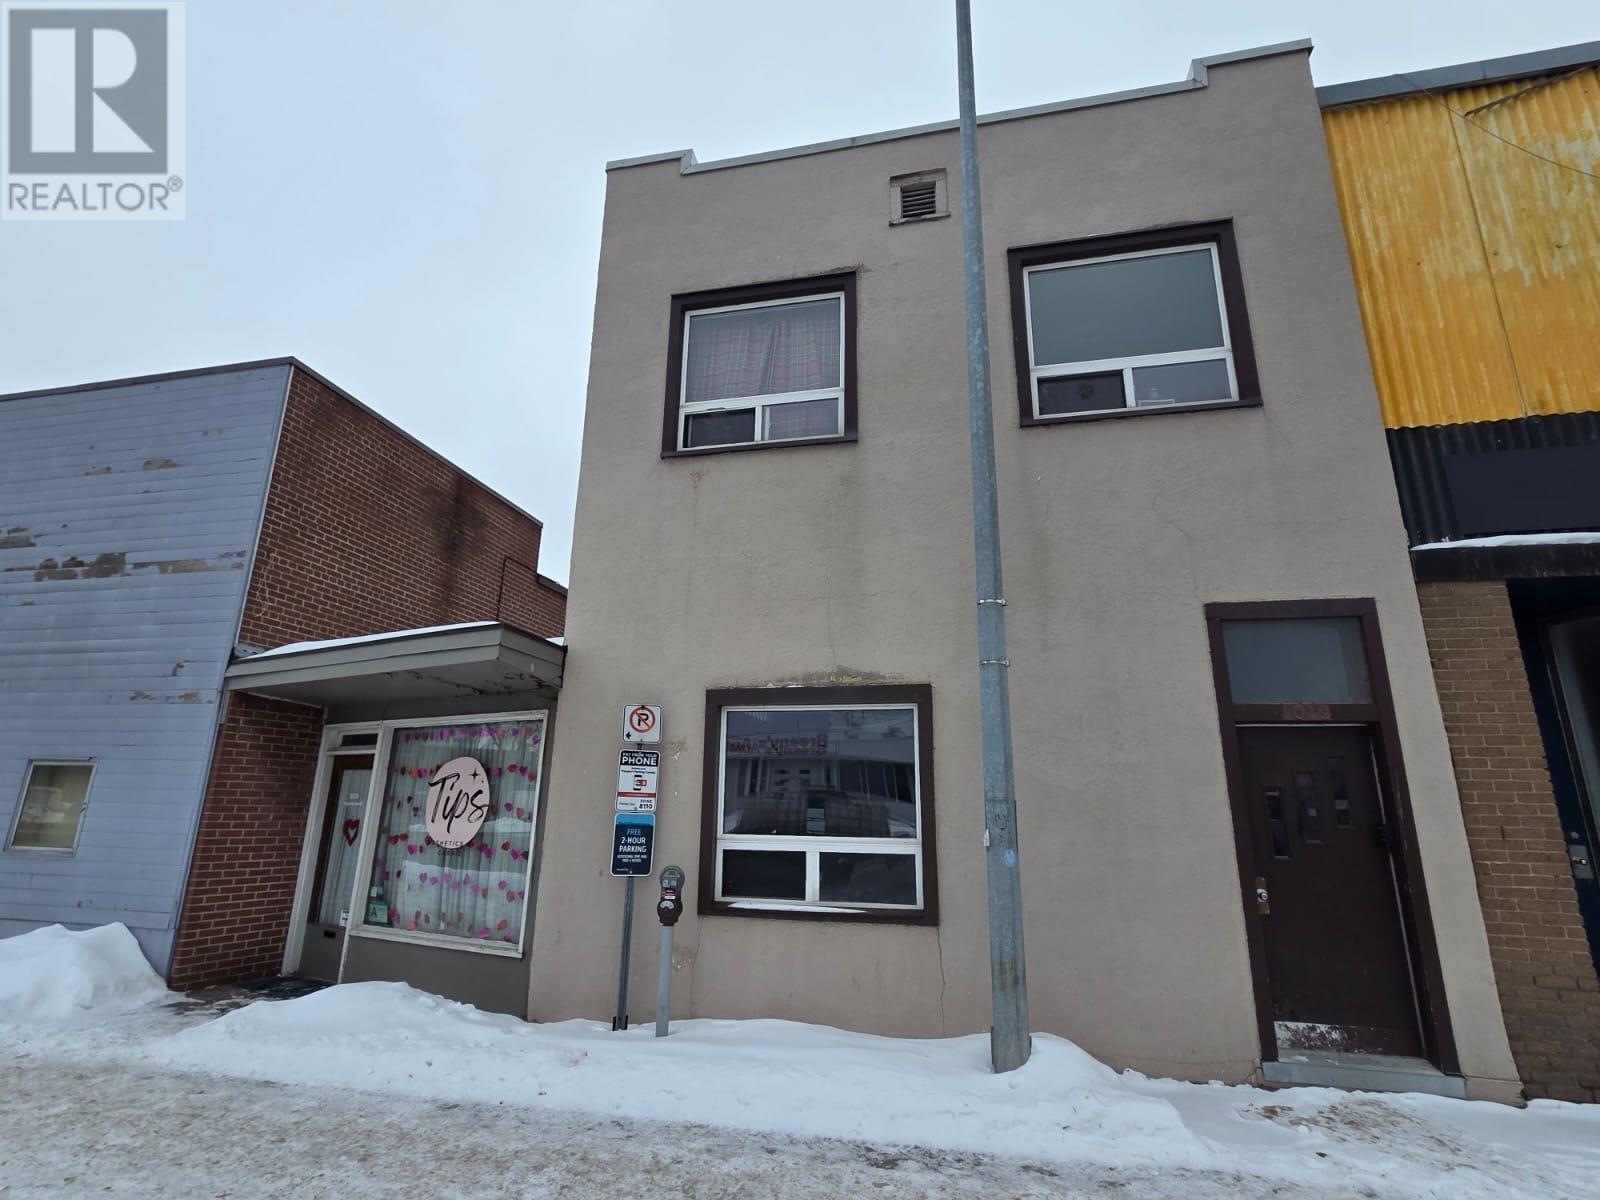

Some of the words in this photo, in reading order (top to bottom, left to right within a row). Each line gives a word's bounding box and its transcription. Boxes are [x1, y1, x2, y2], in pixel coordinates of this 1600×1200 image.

[622, 756, 657, 766] PHONE
[428, 772, 489, 834] Tips
[627, 828, 641, 836] FREE
[620, 836, 646, 844] 2-HOUR
[619, 845, 647, 853] PARKING
